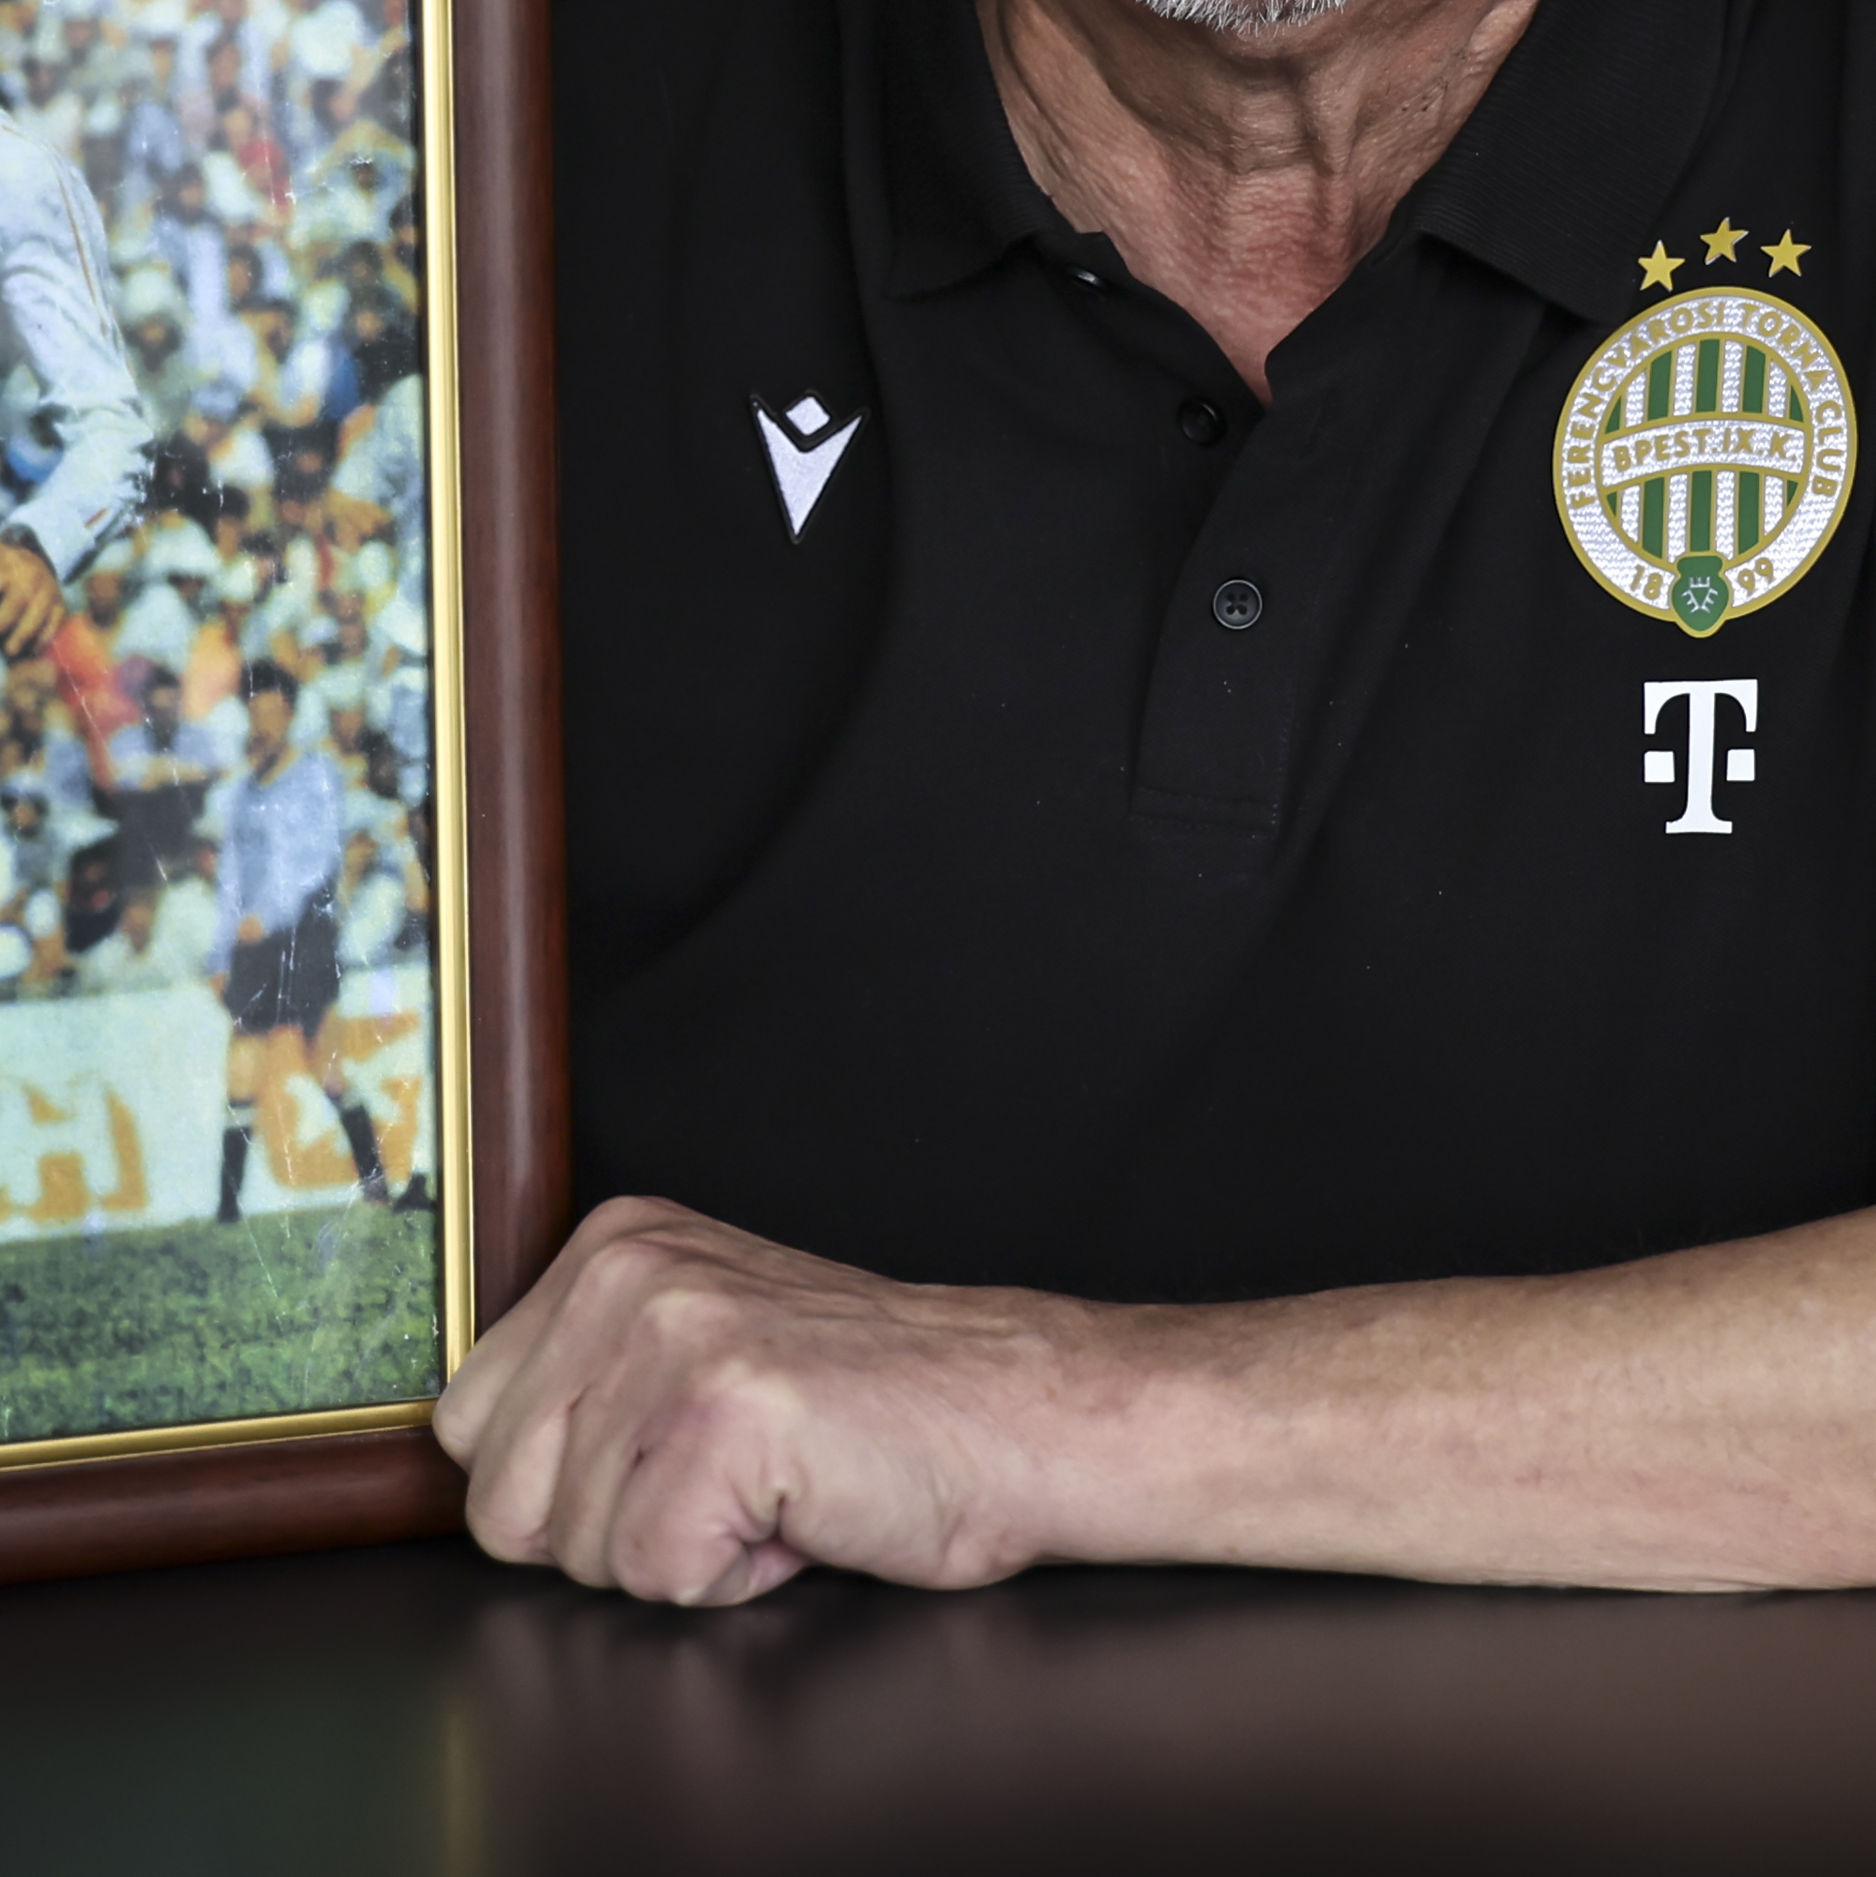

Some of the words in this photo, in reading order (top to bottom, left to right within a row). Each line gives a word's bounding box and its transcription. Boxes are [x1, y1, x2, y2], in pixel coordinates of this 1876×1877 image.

[1739, 302, 1829, 394] TORNA
[1811, 399, 1844, 498] CLUB
[1630, 564, 1664, 600] 18
[1737, 557, 1775, 597] 99
